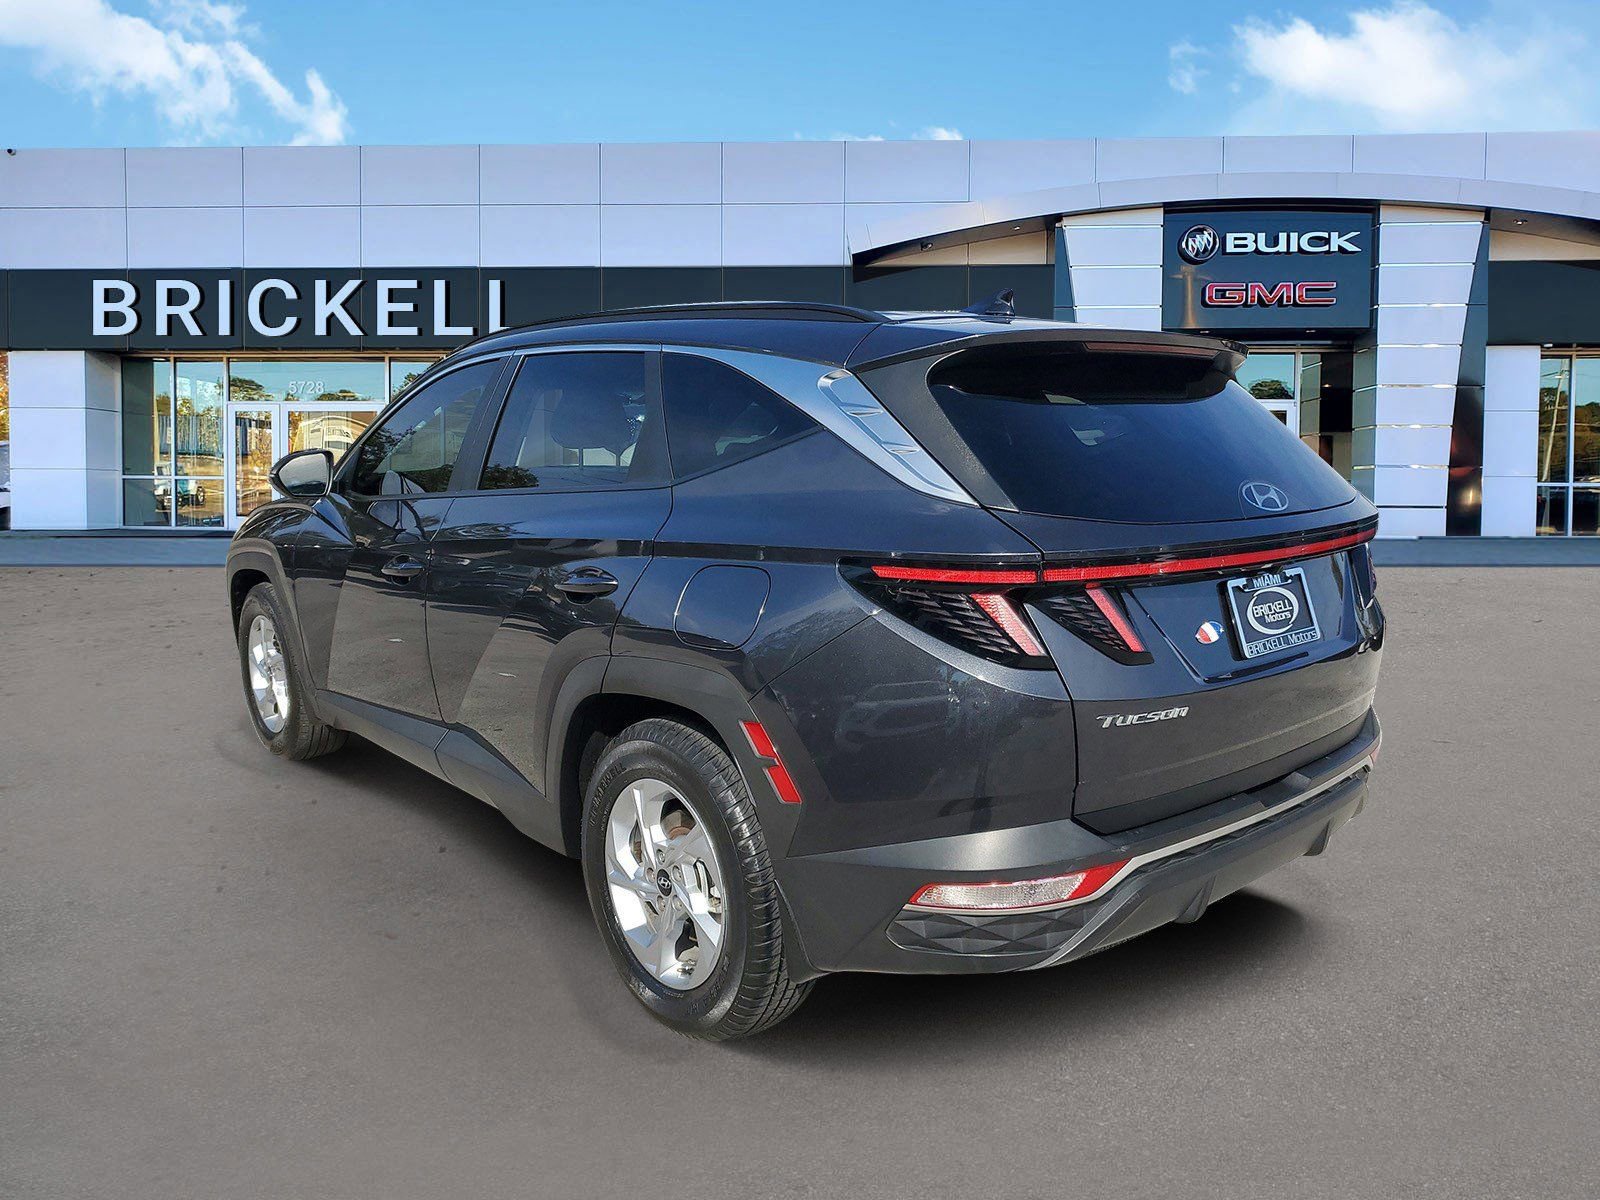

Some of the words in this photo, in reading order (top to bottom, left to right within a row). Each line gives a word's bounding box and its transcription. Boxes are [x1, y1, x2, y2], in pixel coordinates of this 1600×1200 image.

[1225, 231, 1362, 253] BUICK
[1205, 281, 1337, 305] GMC
[91, 279, 510, 337] BRICKELL
[288, 381, 325, 394] 5728
[1252, 574, 1281, 588] MIAMI
[1253, 599, 1293, 618] BRICKELL
[1265, 611, 1291, 623] Motors
[1246, 637, 1287, 656] BRICKELL
[1288, 630, 1317, 645] Motors
